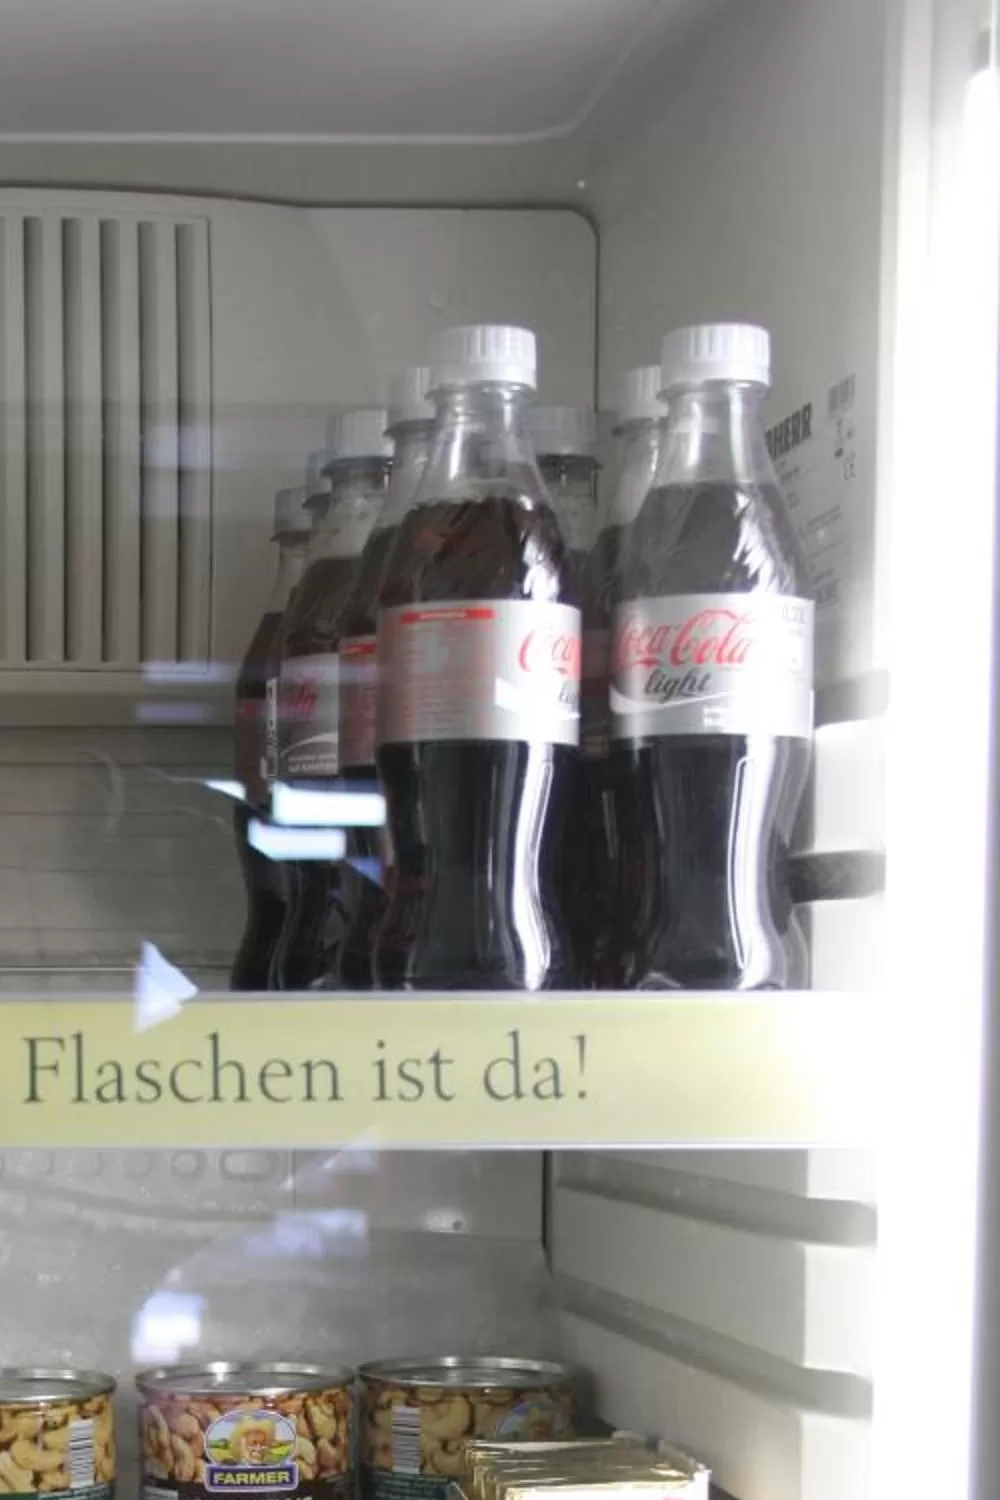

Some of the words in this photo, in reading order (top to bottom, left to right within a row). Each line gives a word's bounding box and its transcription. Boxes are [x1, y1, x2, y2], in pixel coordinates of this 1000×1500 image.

[644, 667, 712, 704] light
[22, 1034, 343, 1105] Flaschen
[372, 1040, 455, 1103] ist
[483, 1034, 588, 1102] da!
[213, 1471, 291, 1485] FARMER
